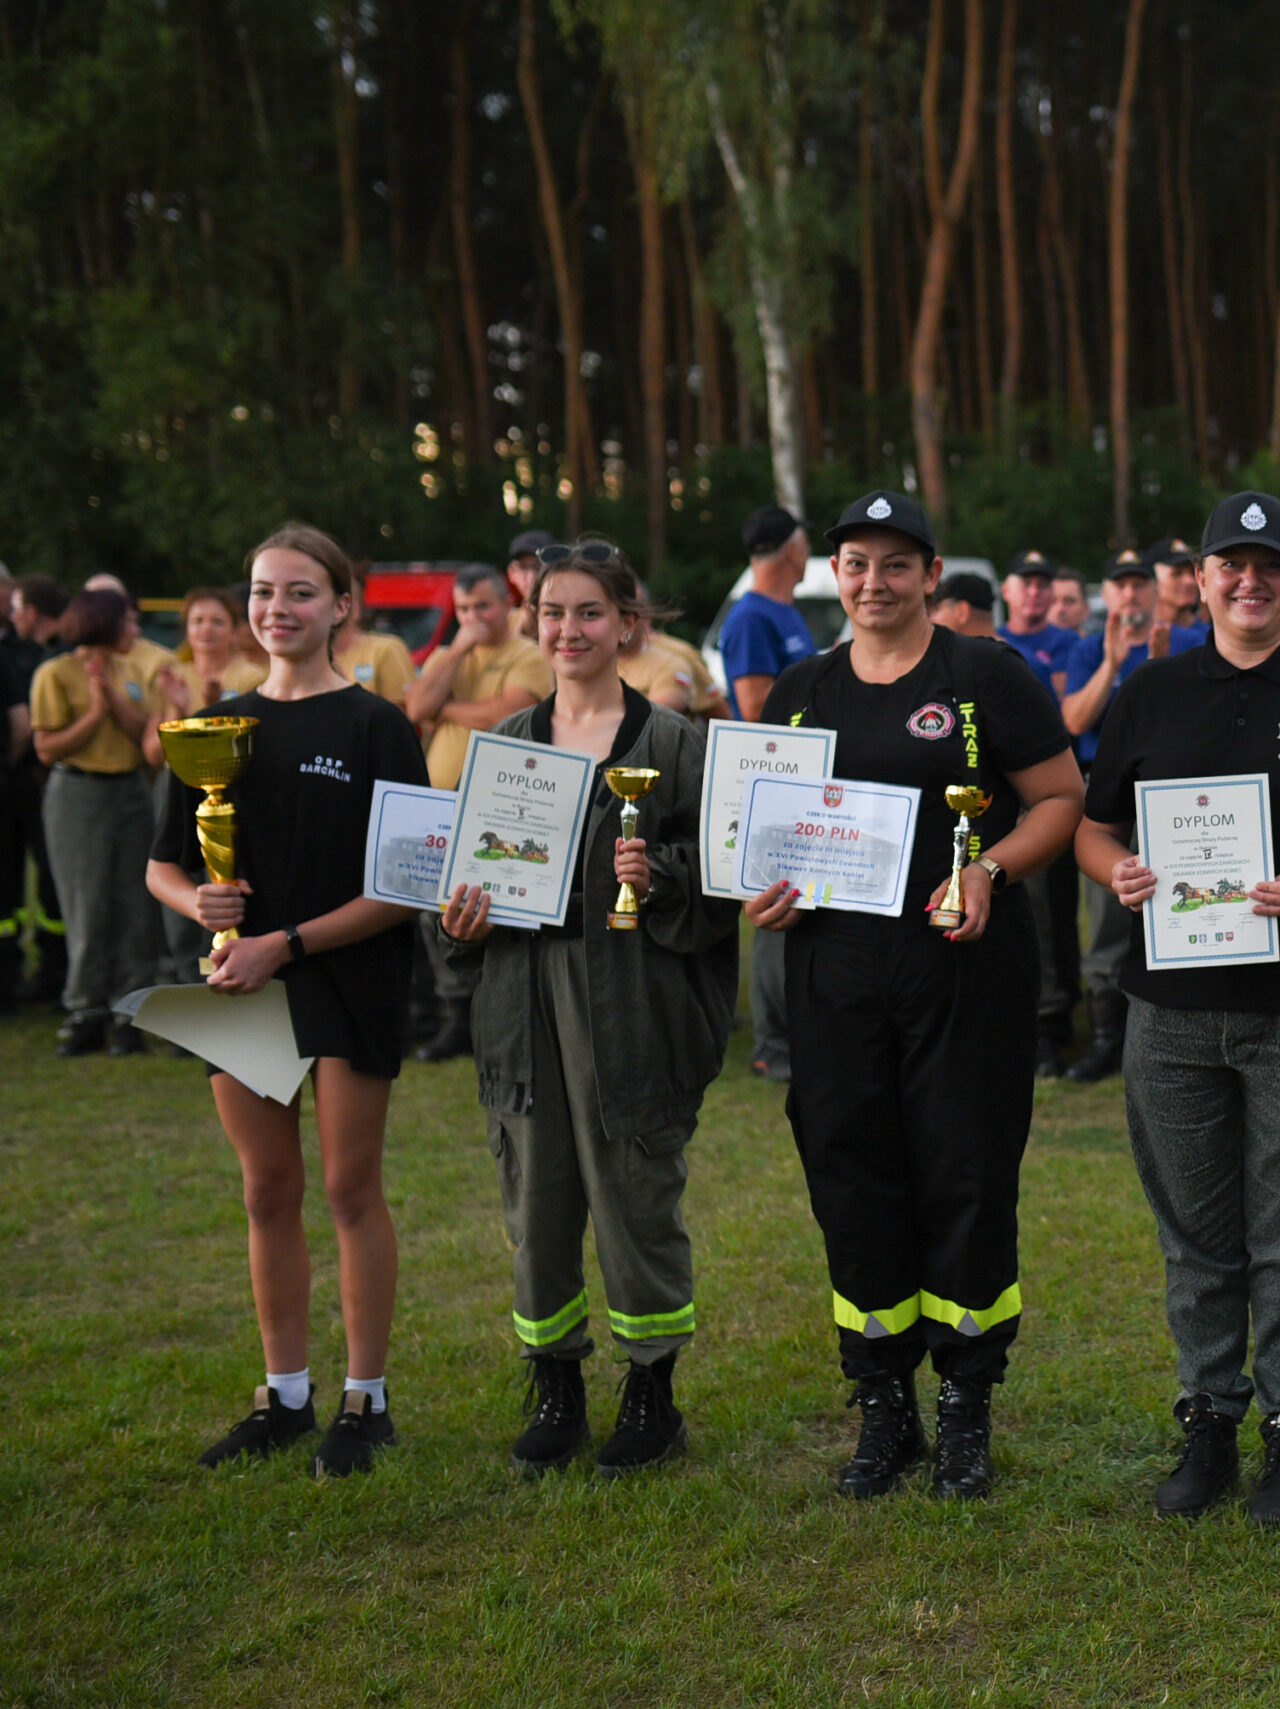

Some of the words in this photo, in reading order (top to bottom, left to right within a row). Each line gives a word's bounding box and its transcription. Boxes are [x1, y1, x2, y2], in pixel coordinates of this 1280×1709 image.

[315, 755, 343, 768] OSP
[740, 758, 799, 774] DYPLOM
[300, 763, 351, 782] BARCHLIN
[497, 771, 556, 793] DYPLOM
[1173, 813, 1235, 829] DYPLOM
[794, 822, 825, 838] 200
[830, 827, 860, 841] PLN
[775, 852, 789, 860] XVI
[790, 854, 838, 867] Powiatowych
[834, 845, 865, 858] miejsca
[427, 855, 444, 865] zaję
